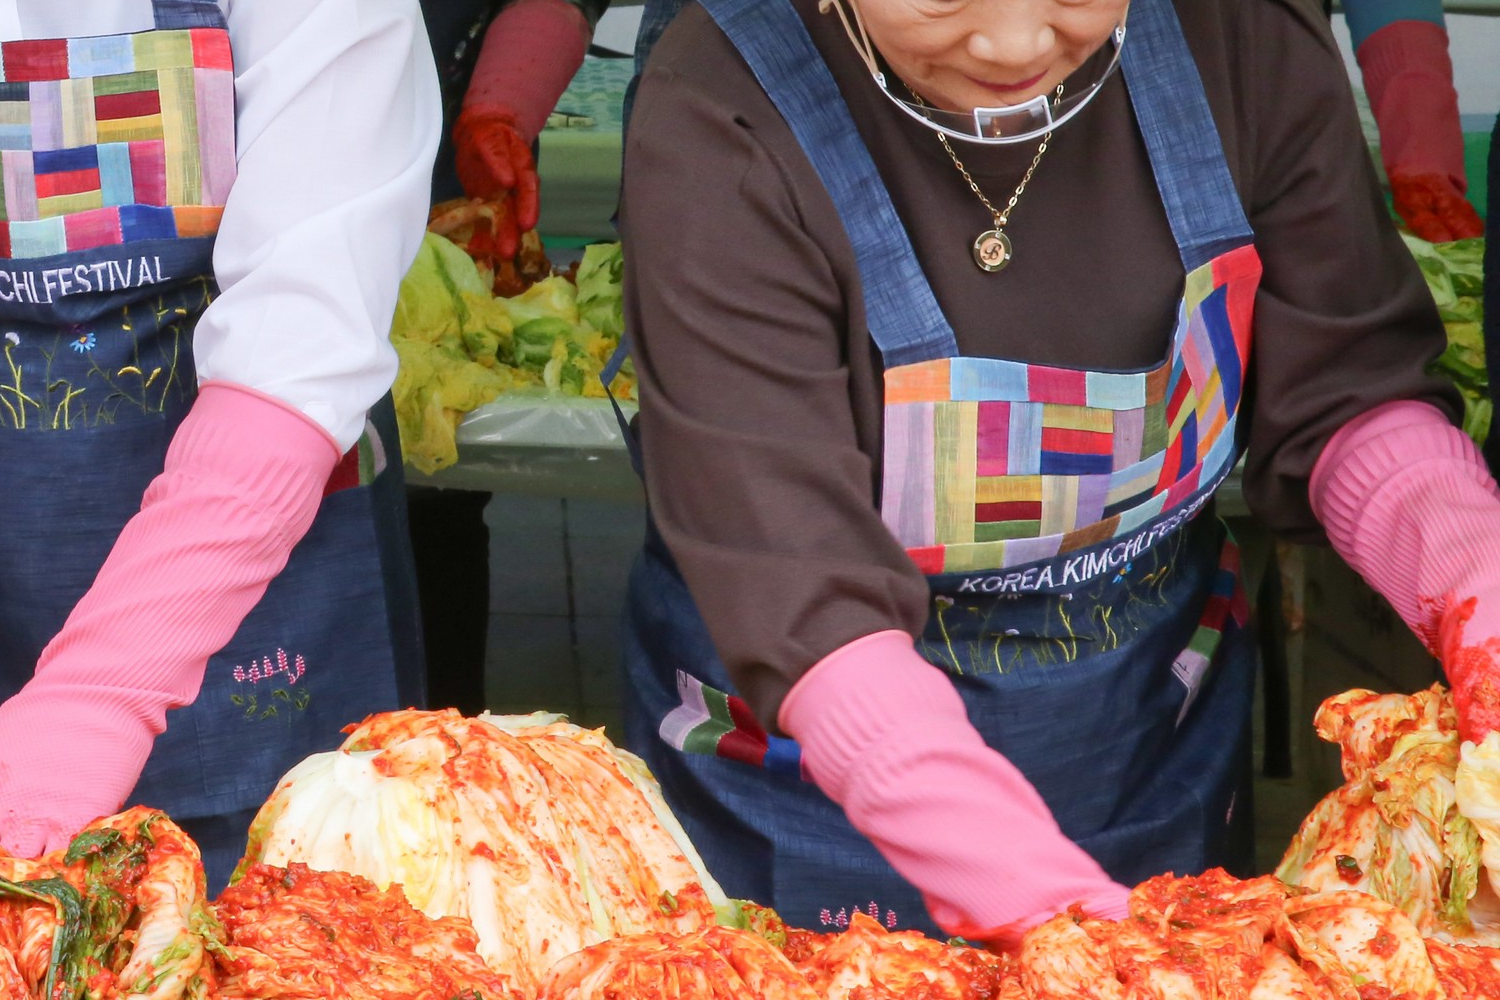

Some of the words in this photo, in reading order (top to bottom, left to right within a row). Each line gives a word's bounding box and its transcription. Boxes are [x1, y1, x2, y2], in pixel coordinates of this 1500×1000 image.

[43, 256, 171, 303] FESTIVAL
[958, 565, 1054, 593] KOREA
[1061, 531, 1147, 586] KIMCHI
